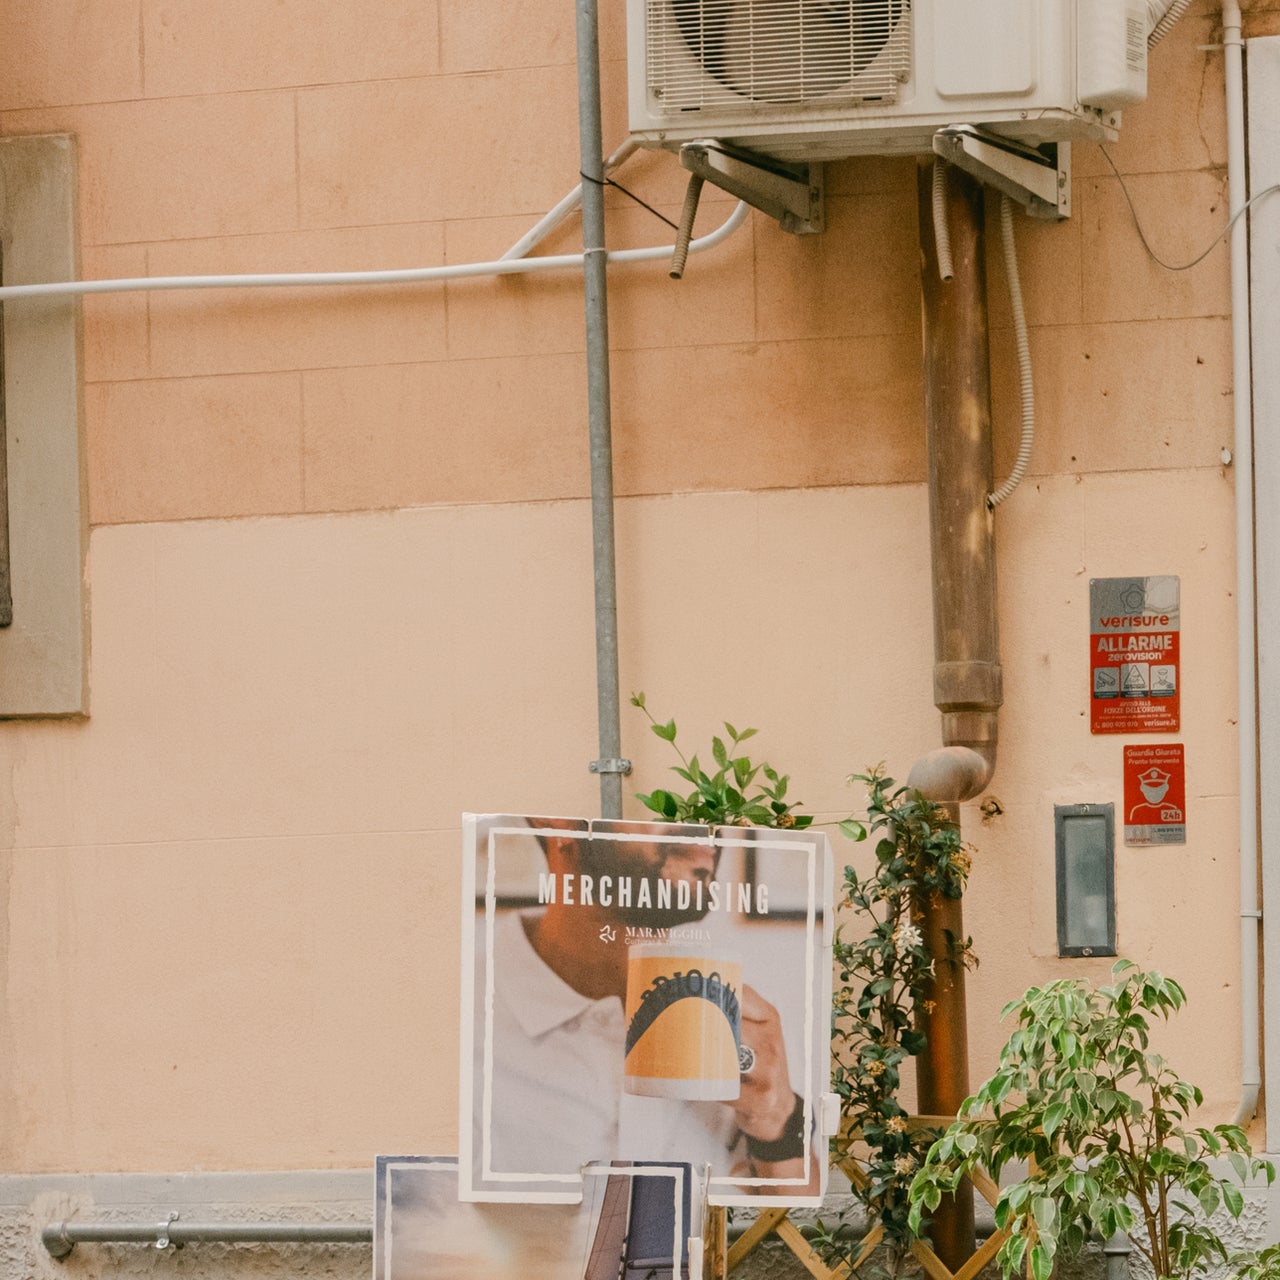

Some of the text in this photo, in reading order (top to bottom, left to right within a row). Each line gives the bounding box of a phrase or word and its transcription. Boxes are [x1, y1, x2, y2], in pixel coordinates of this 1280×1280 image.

[1100, 615, 1169, 628] verisure
[1097, 634, 1173, 652] ALLARME
[1126, 748, 1181, 757] Guardia Giurata
[1163, 811, 1180, 820] 24h
[538, 872, 769, 915] MERCHANDISING
